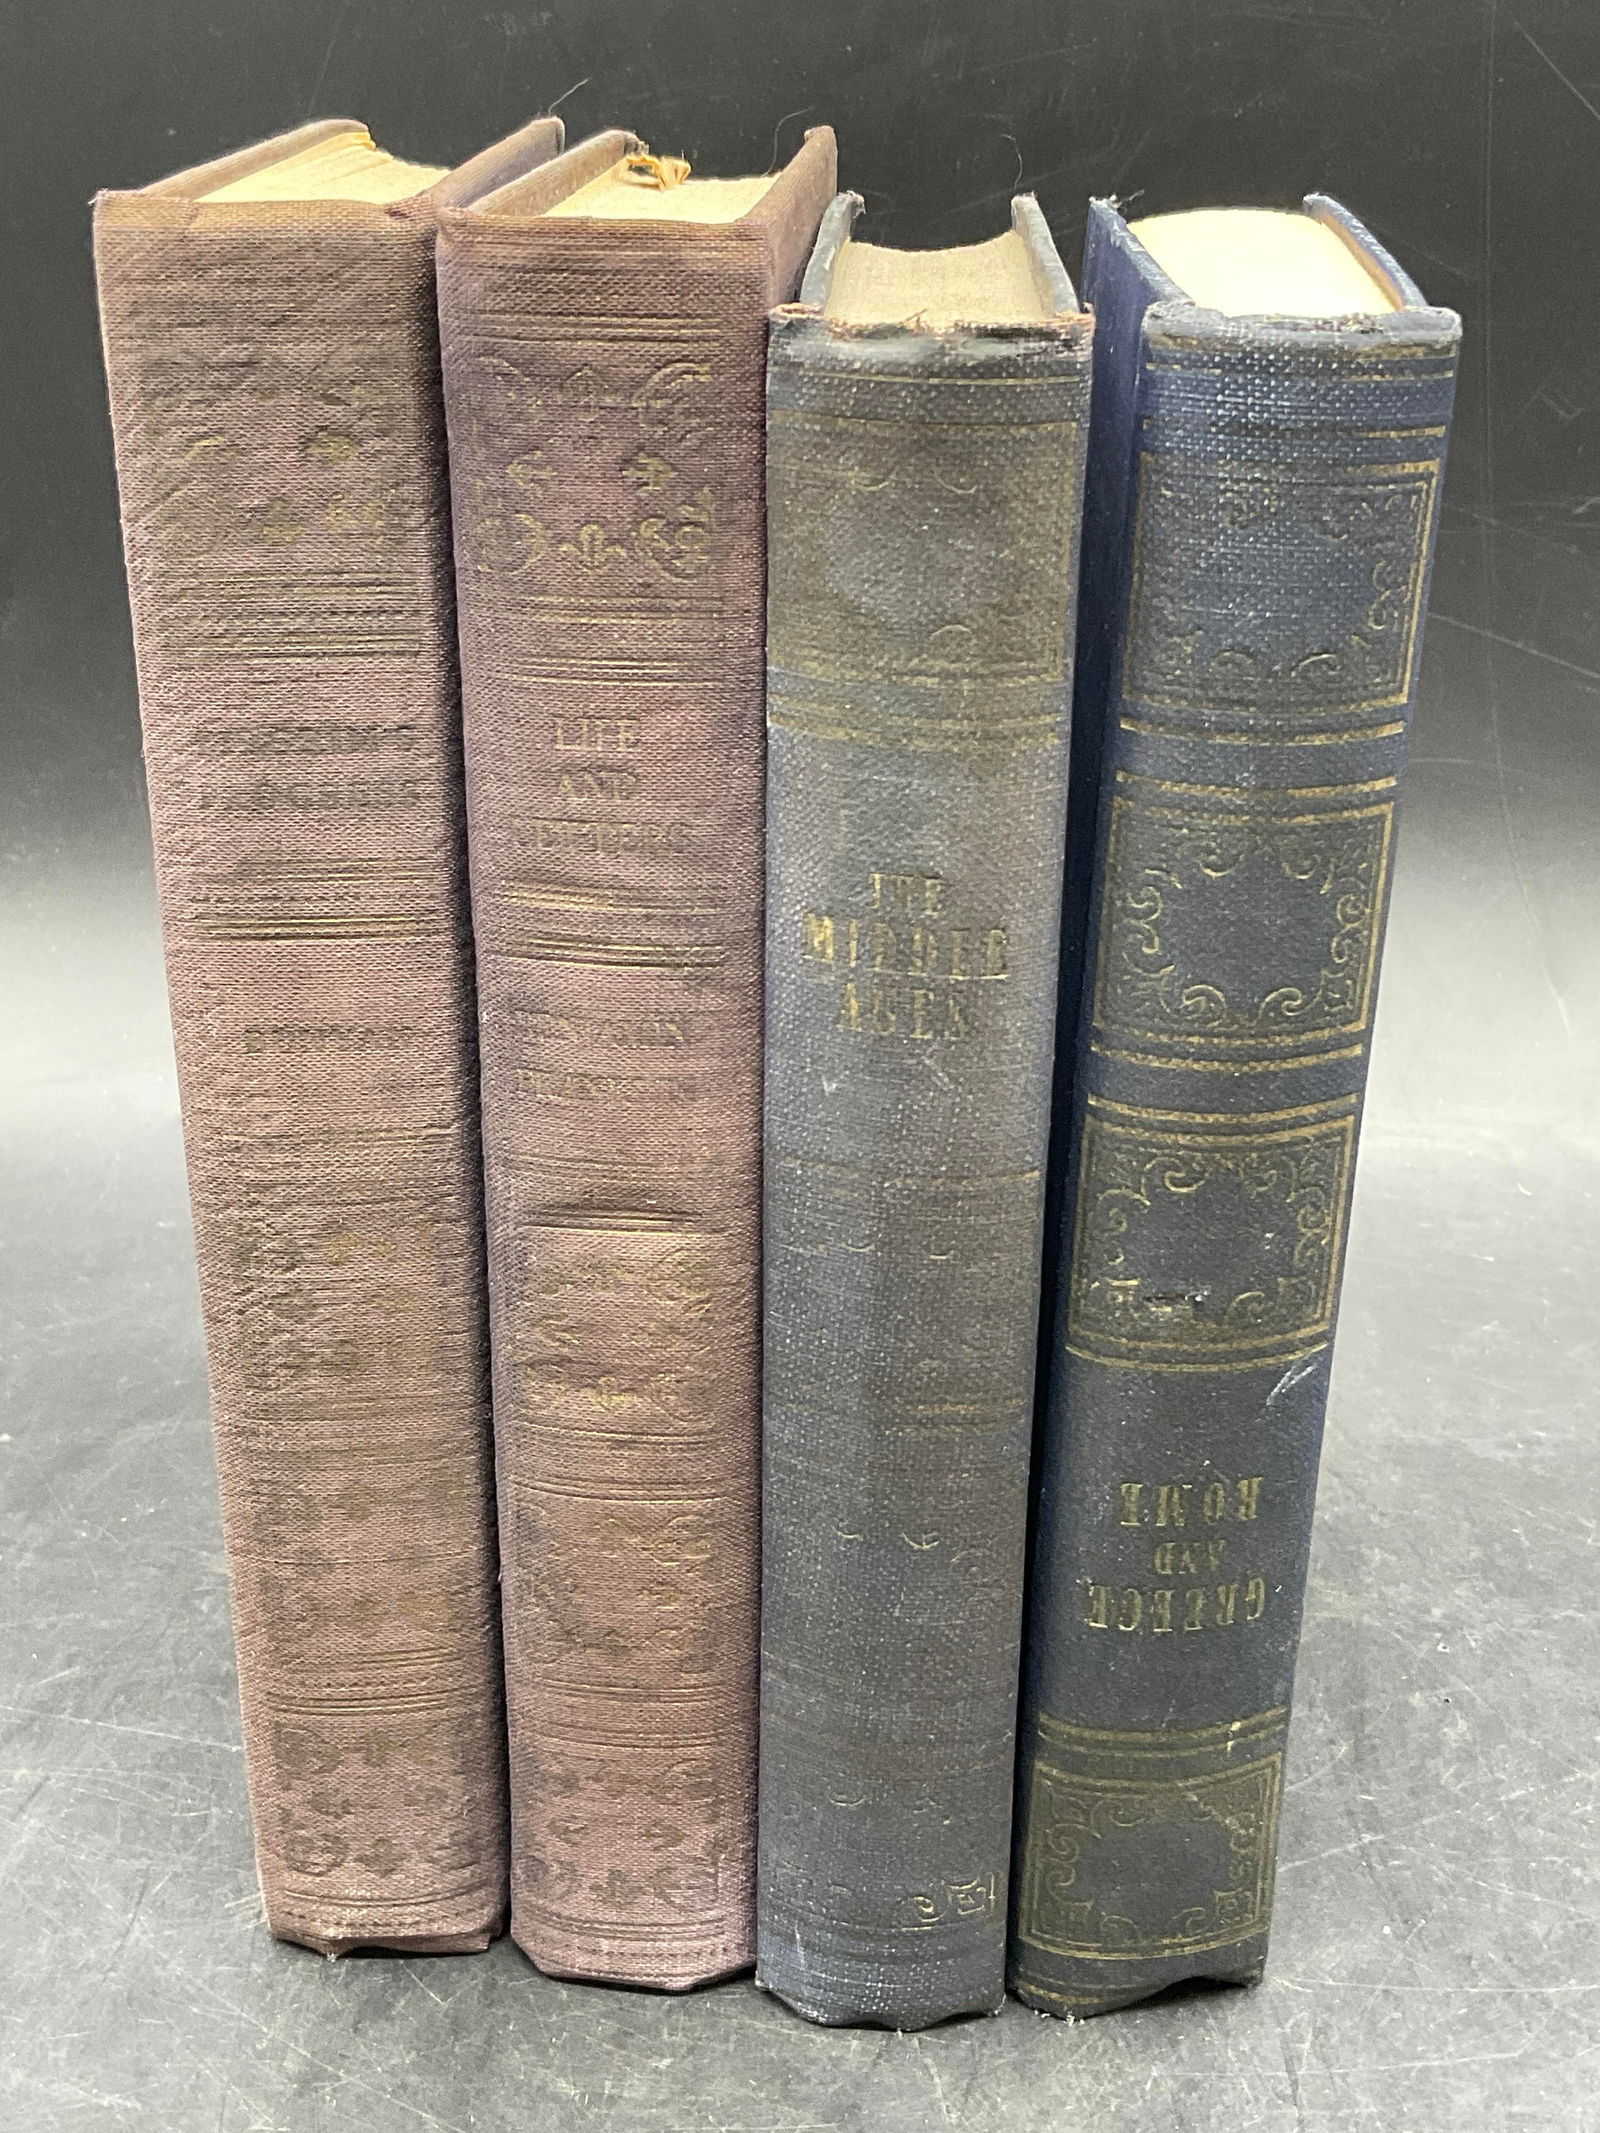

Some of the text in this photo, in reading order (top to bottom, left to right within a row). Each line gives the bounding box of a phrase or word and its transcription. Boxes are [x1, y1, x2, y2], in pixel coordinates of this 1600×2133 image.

[552, 715, 641, 753] LIFE
[1119, 1476, 1265, 1528] ROME
[1153, 1539, 1228, 1576] AND
[1083, 1576, 1267, 1633] GREECE
